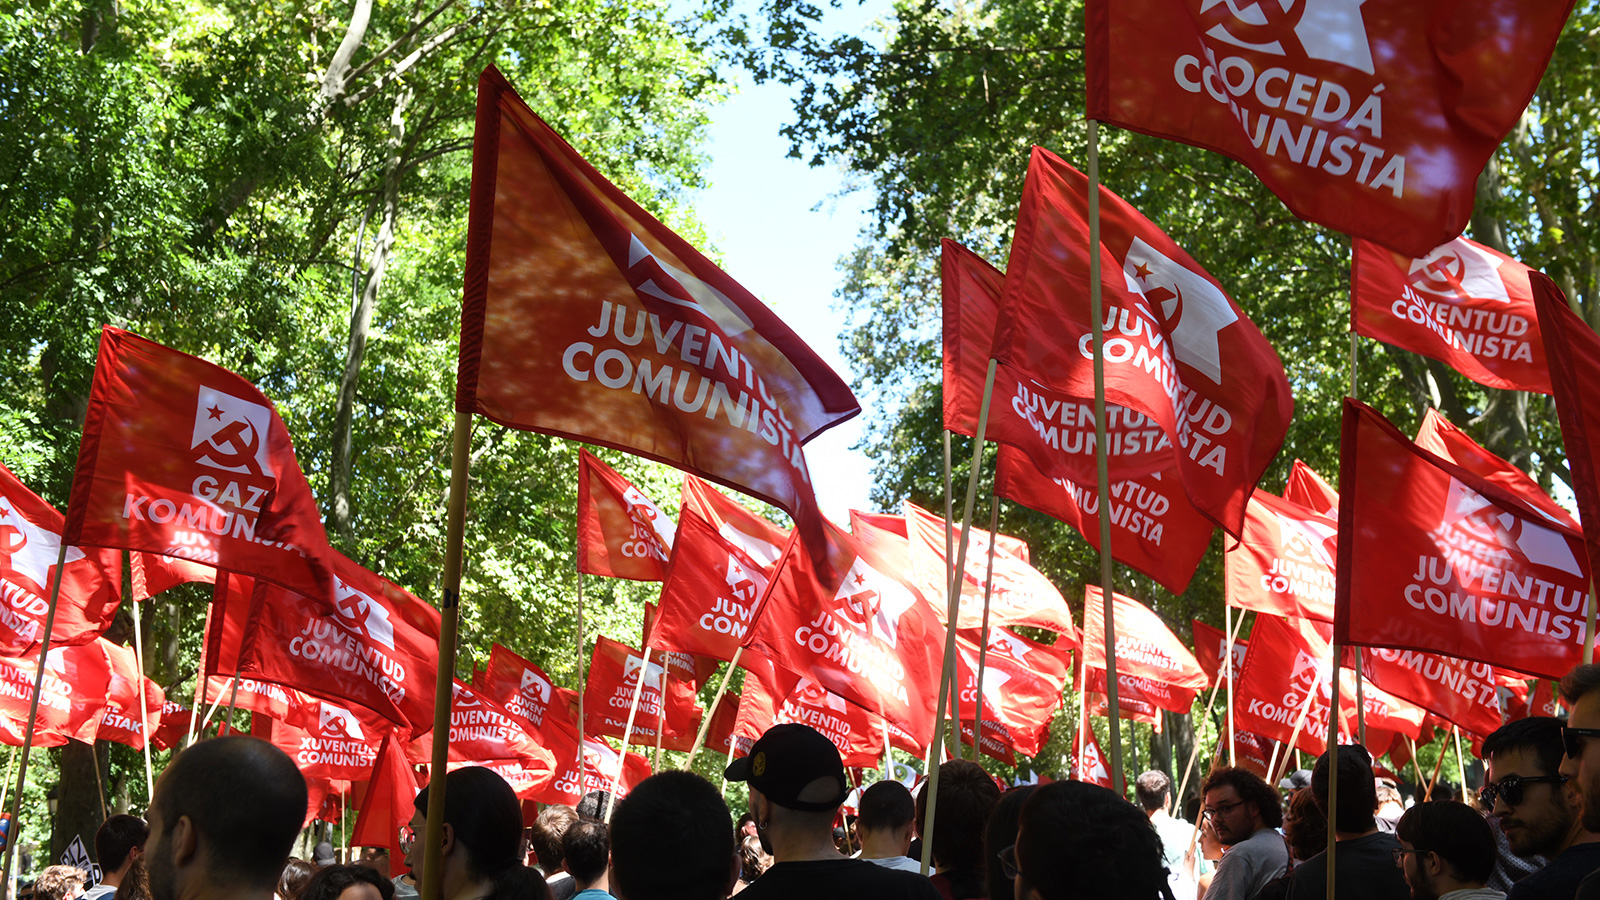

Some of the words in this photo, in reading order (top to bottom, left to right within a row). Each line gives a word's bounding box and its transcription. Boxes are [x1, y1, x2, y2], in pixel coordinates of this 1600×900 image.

[1207, 46, 1386, 139] OCEDÁ
[1402, 285, 1528, 337] JUVENTUD
[1391, 300, 1533, 364] COMUNISTA
[562, 342, 809, 485] COMUNISTA
[192, 475, 270, 513] GAZ
[1260, 574, 1336, 605] COMUNI
[301, 617, 405, 682] JUVENTUD
[0, 664, 73, 696] UVENTUD
[289, 636, 406, 705] COMUNISTA
[451, 710, 522, 731] UVENTUD
[504, 702, 542, 727] COMUN
[511, 694, 546, 716] JUVEN
[101, 713, 142, 734] ISTAK
[449, 726, 528, 745] OMUNISTA
[297, 750, 376, 767] COMUNIST
